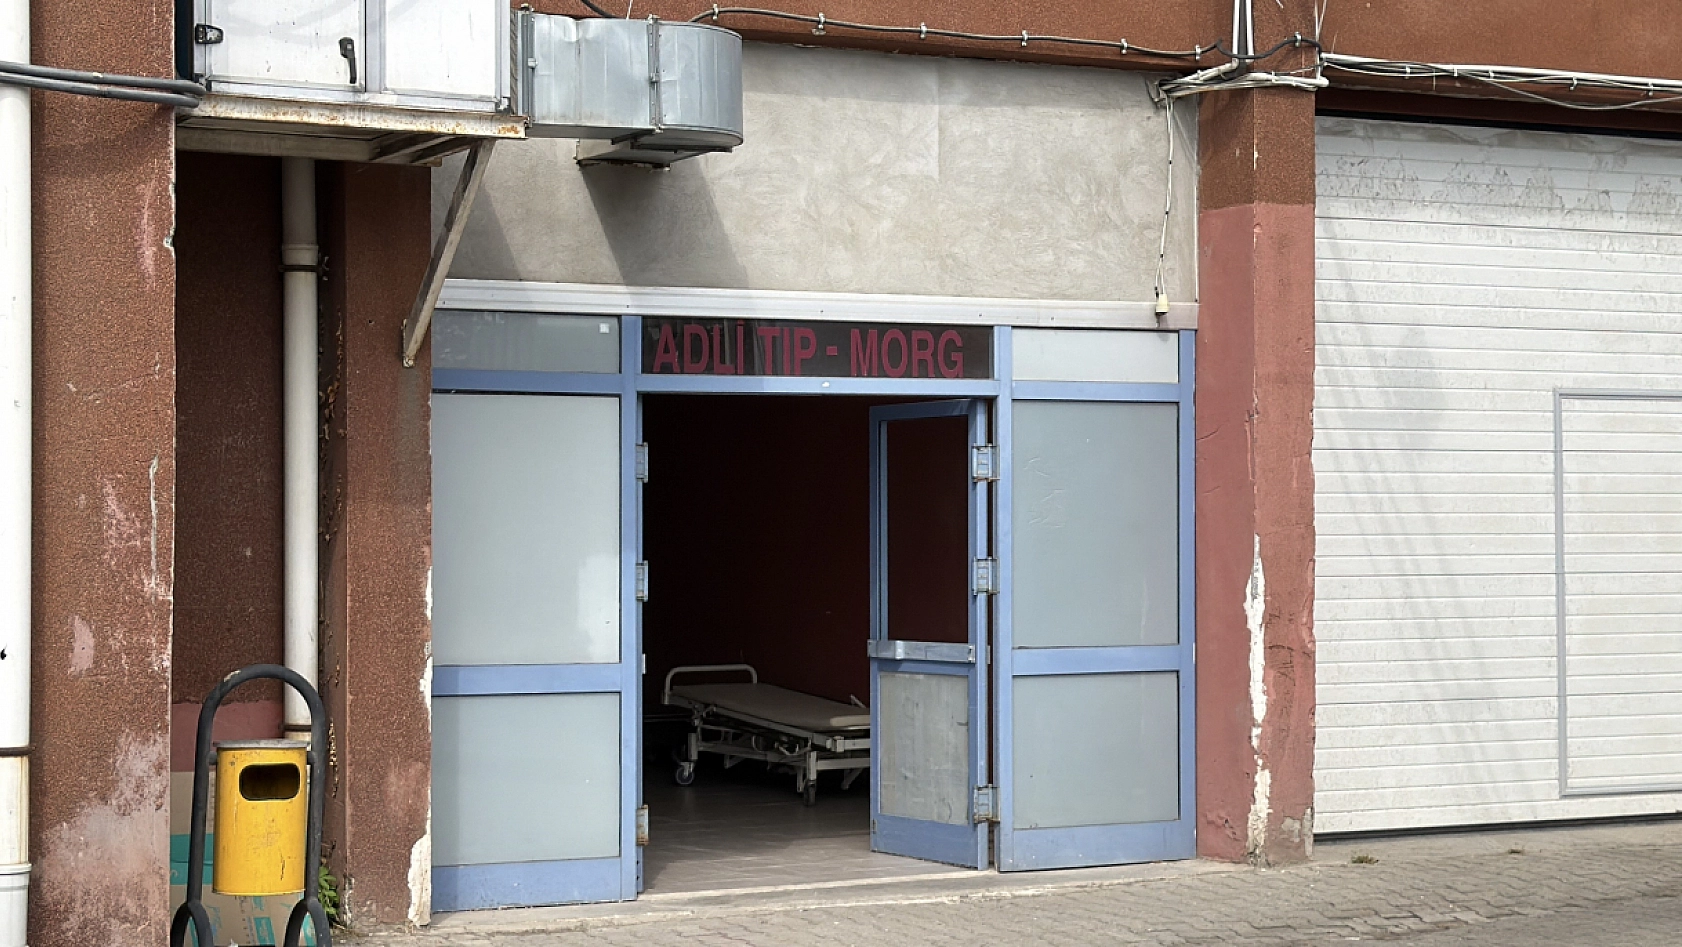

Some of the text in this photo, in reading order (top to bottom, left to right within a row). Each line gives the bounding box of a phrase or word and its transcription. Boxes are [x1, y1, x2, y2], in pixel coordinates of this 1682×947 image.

[652, 320, 964, 378] ADLİ TIP - MORG
